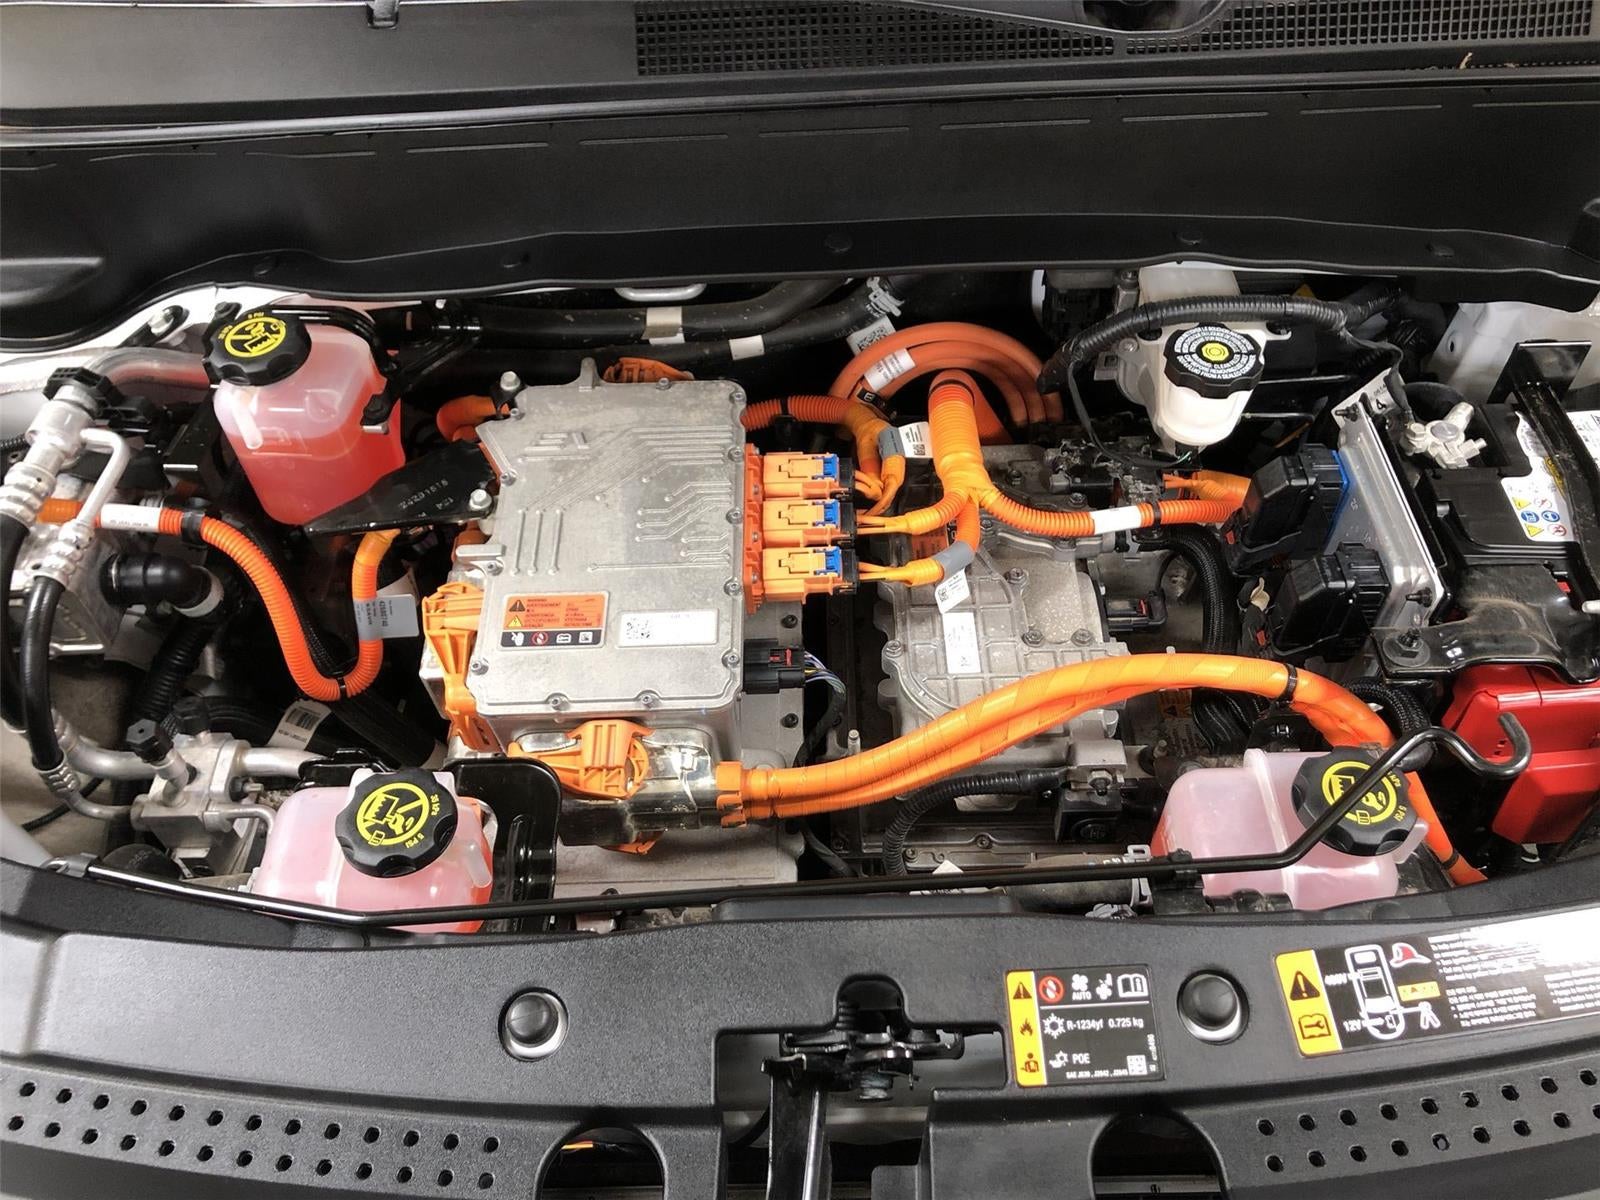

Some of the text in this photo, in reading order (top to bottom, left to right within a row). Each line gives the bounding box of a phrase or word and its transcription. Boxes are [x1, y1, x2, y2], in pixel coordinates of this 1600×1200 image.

[1394, 811, 1406, 822] PSI
[405, 837, 419, 849] PSI
[1072, 991, 1092, 1001] AUTO
[1108, 1017, 1131, 1028] 0.725
[1133, 1017, 1144, 1029] kg
[1343, 1020, 1362, 1032] 12V
[1072, 1053, 1090, 1064] POE
